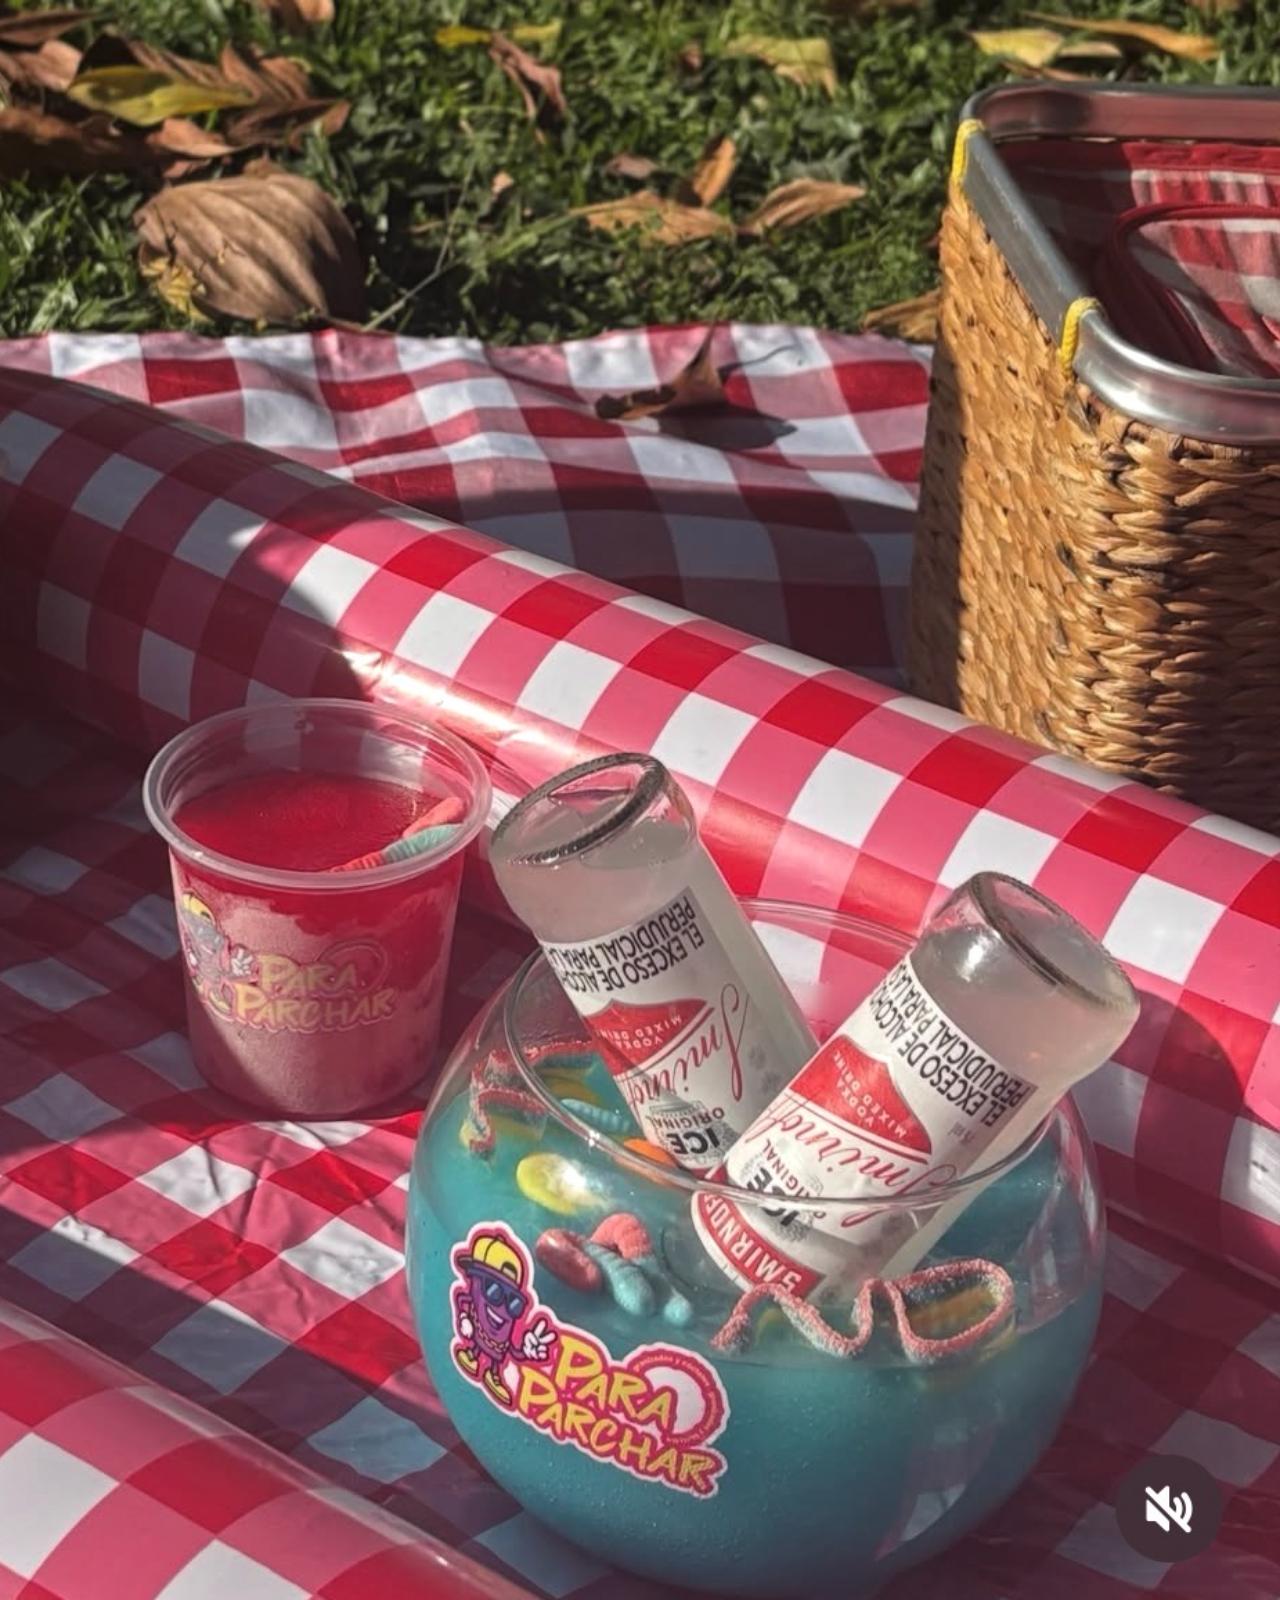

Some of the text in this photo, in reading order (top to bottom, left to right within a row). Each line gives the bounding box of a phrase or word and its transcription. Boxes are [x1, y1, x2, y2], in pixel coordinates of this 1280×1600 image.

[595, 896, 696, 965] PERJUDICIAL
[681, 922, 705, 949] EL
[257, 954, 357, 996] PARA
[560, 947, 601, 969] PARA
[596, 967, 626, 992] DE
[625, 934, 688, 984] EXCESO
[234, 983, 397, 1027] PARCHAR
[635, 1015, 682, 1037] MIXED
[902, 987, 937, 1035] PARA
[615, 1036, 663, 1049] VODKA
[625, 983, 749, 1123] Smirnof
[870, 985, 1007, 1127] EL EXCESO DE ALCOHO
[928, 1020, 1030, 1109] PERJUDICIAL
[645, 1107, 725, 1129] ORIGINAL
[833, 1050, 907, 1138] MIXED DRINK
[836, 1078, 874, 1127] VODKA
[666, 1128, 720, 1155] ICE
[745, 1090, 957, 1228] Smirnoff
[554, 1334, 672, 1430] PARA
[518, 1366, 714, 1489] PARCHAR
